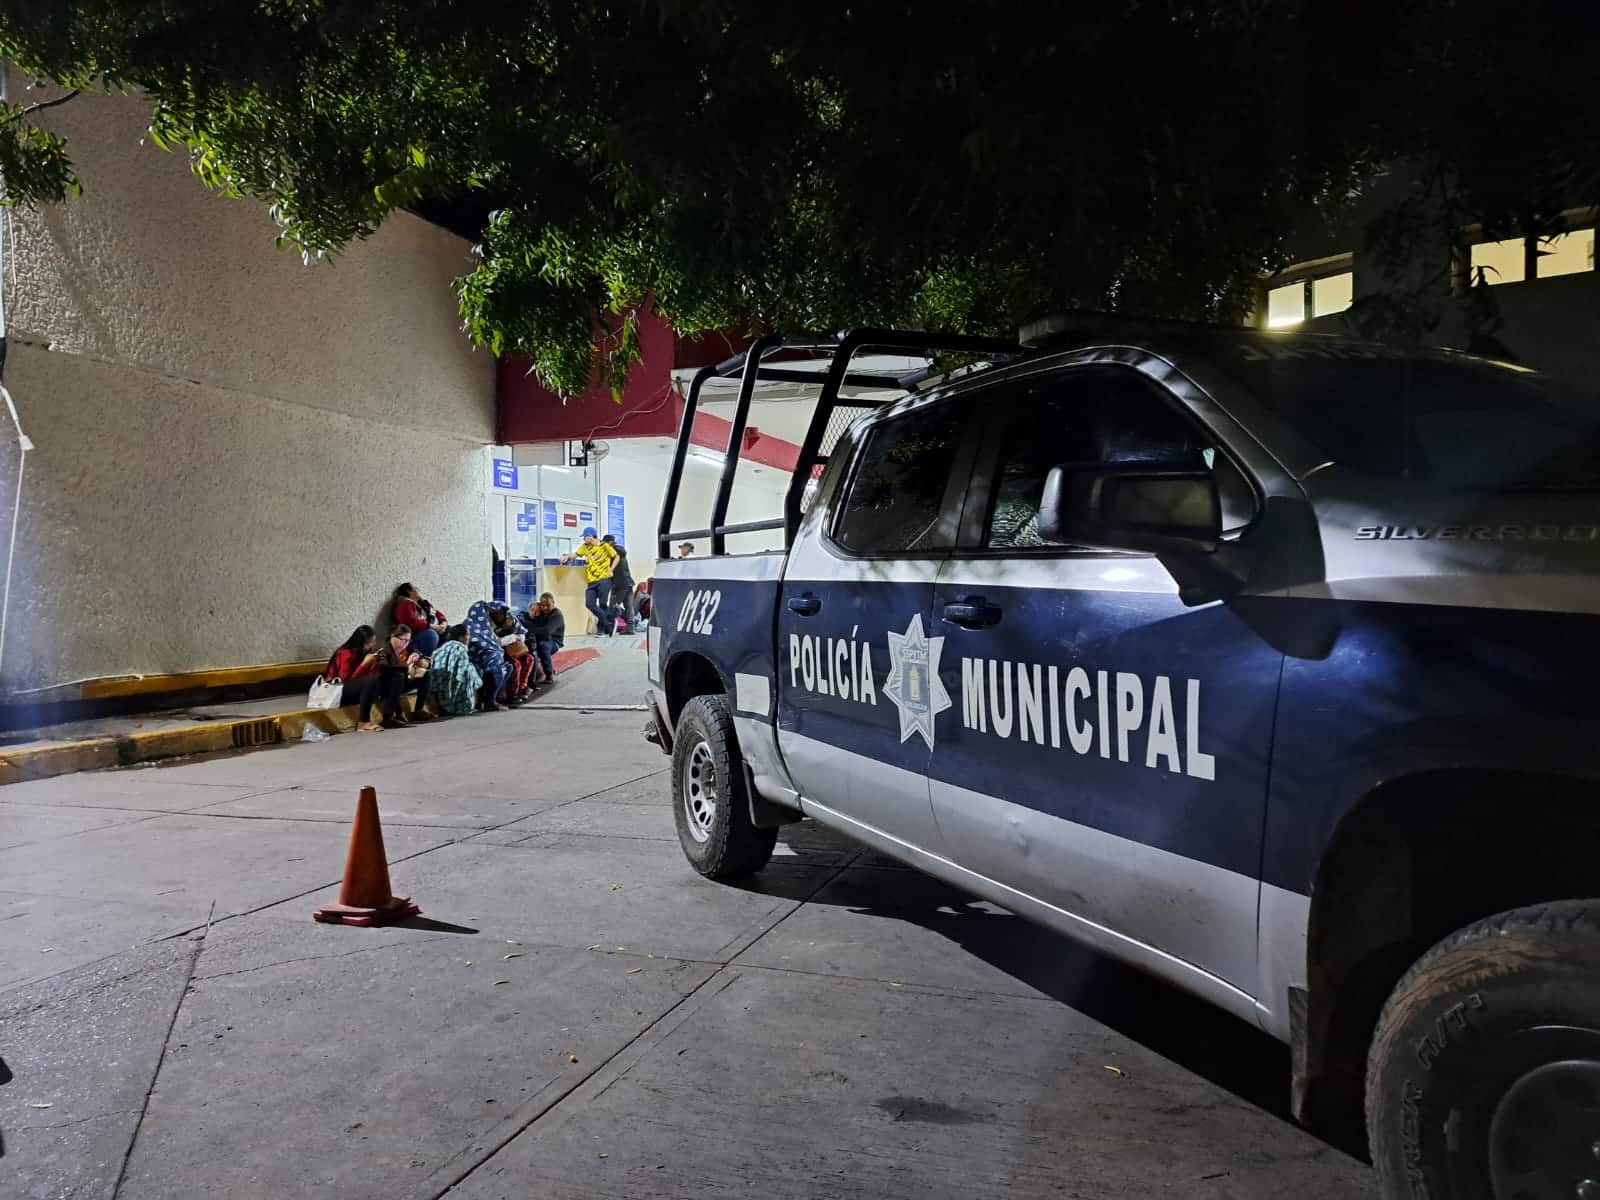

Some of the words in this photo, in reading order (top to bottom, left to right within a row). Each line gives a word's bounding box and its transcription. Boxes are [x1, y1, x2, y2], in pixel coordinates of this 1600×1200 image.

[677, 589, 721, 636] 0132
[789, 624, 877, 706] POLICÍA
[962, 656, 1216, 781] MUNICIPAL
